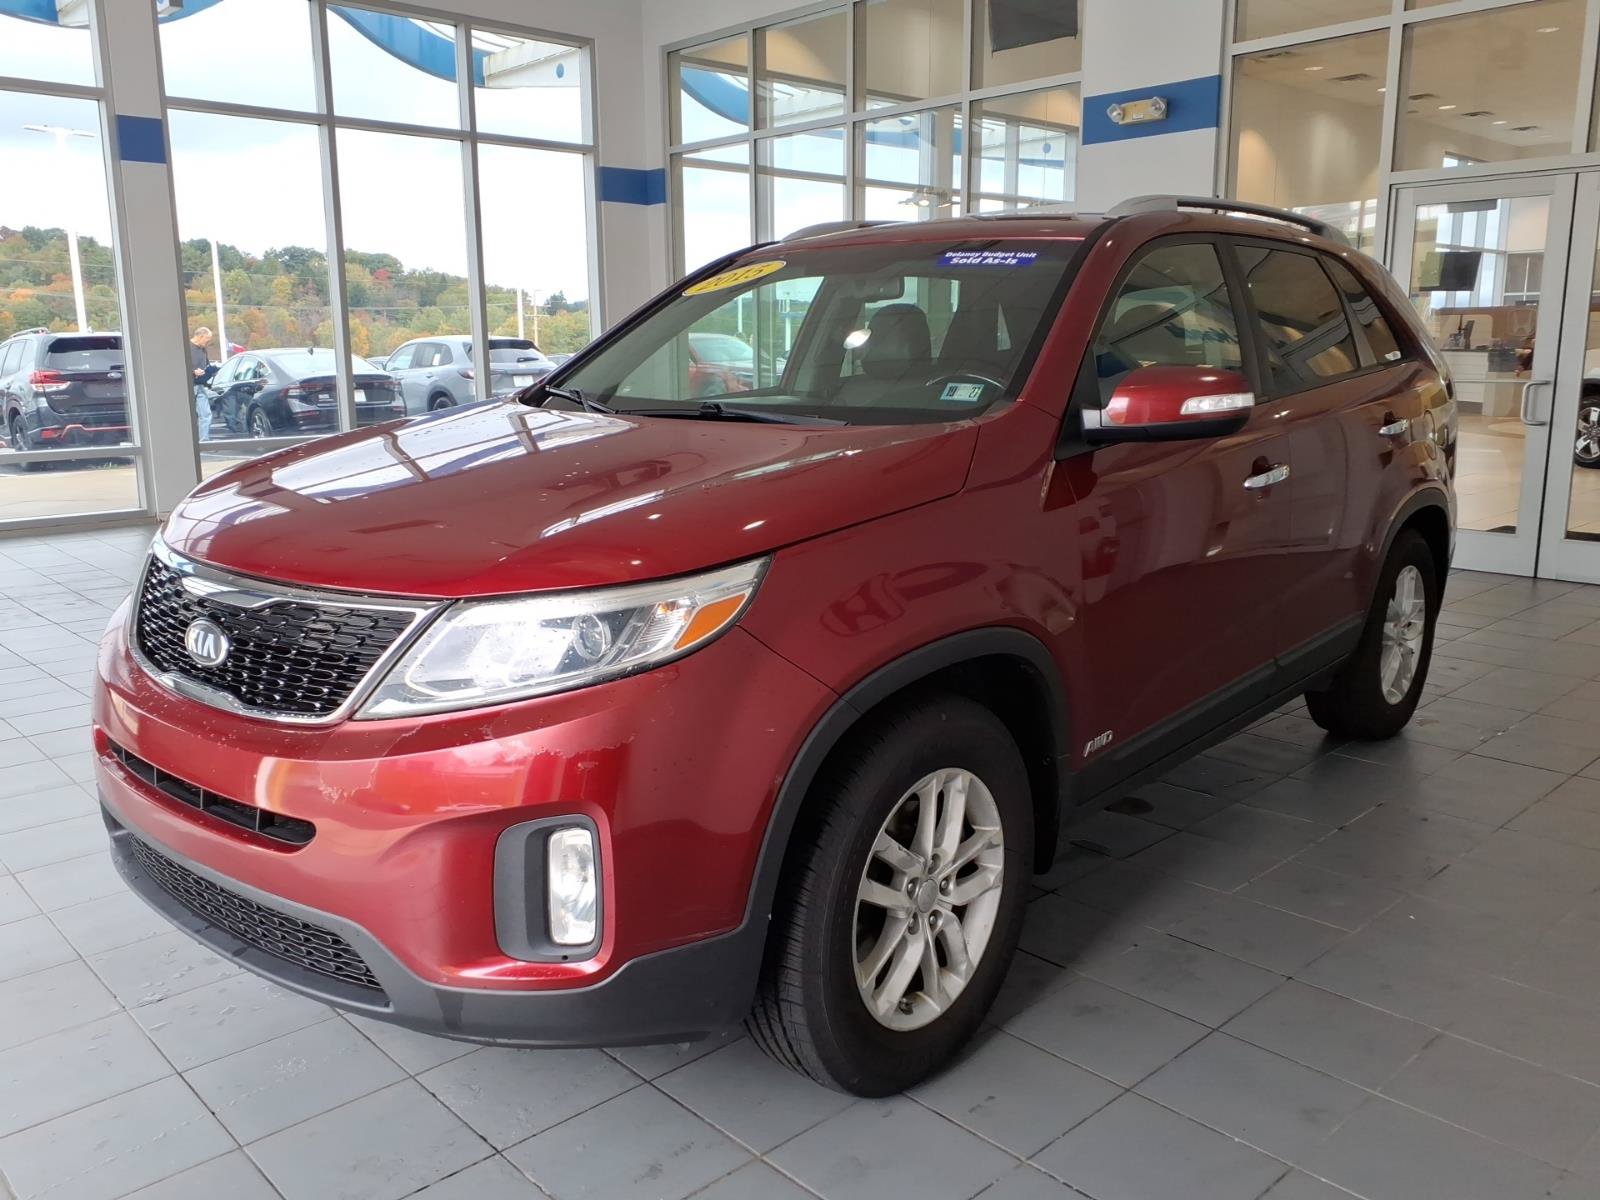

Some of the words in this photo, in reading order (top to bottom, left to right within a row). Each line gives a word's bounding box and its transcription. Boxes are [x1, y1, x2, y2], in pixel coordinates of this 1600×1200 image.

[982, 257, 1018, 265] As-Is
[691, 264, 773, 292] 2015
[188, 627, 217, 659] KIA
[1083, 729, 1112, 758] AWD
